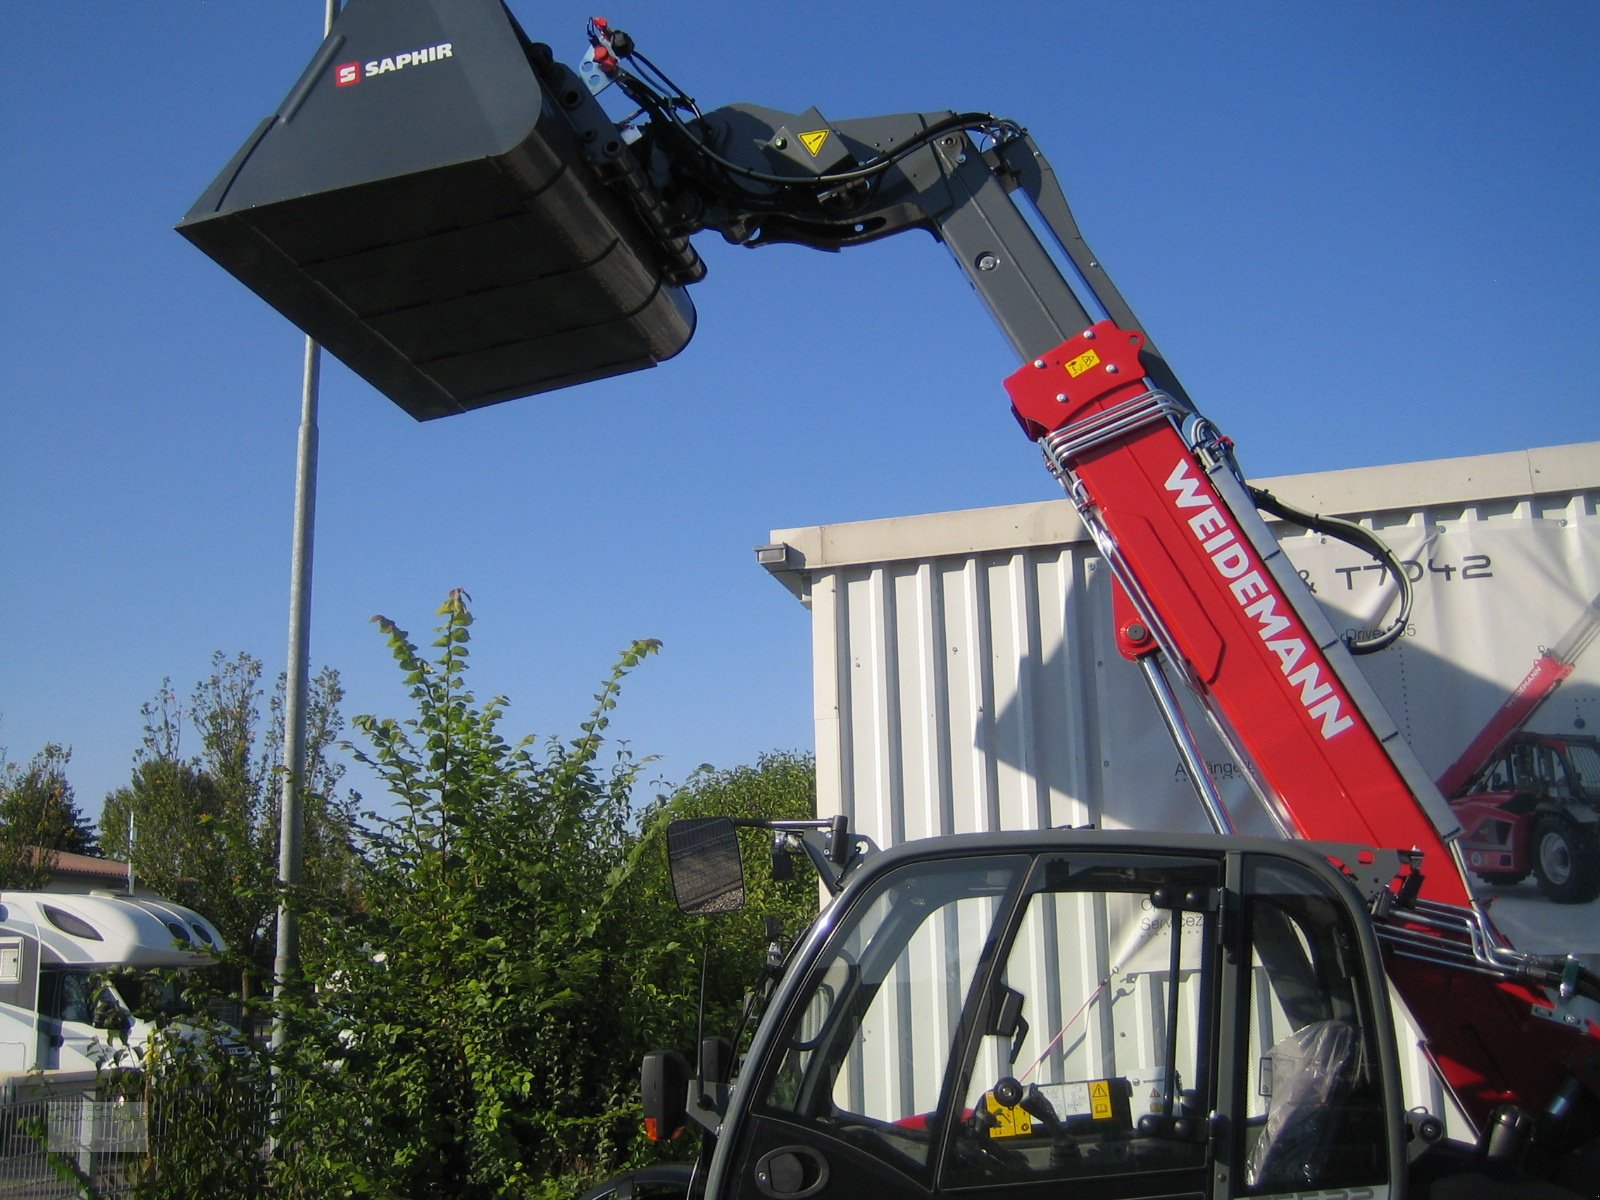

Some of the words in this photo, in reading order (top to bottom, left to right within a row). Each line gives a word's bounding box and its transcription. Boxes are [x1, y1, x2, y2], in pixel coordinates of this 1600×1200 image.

[365, 43, 453, 77] SAPHIR
[1335, 554, 1493, 590] T7042
[1164, 459, 1354, 740] WEIDEMANN
